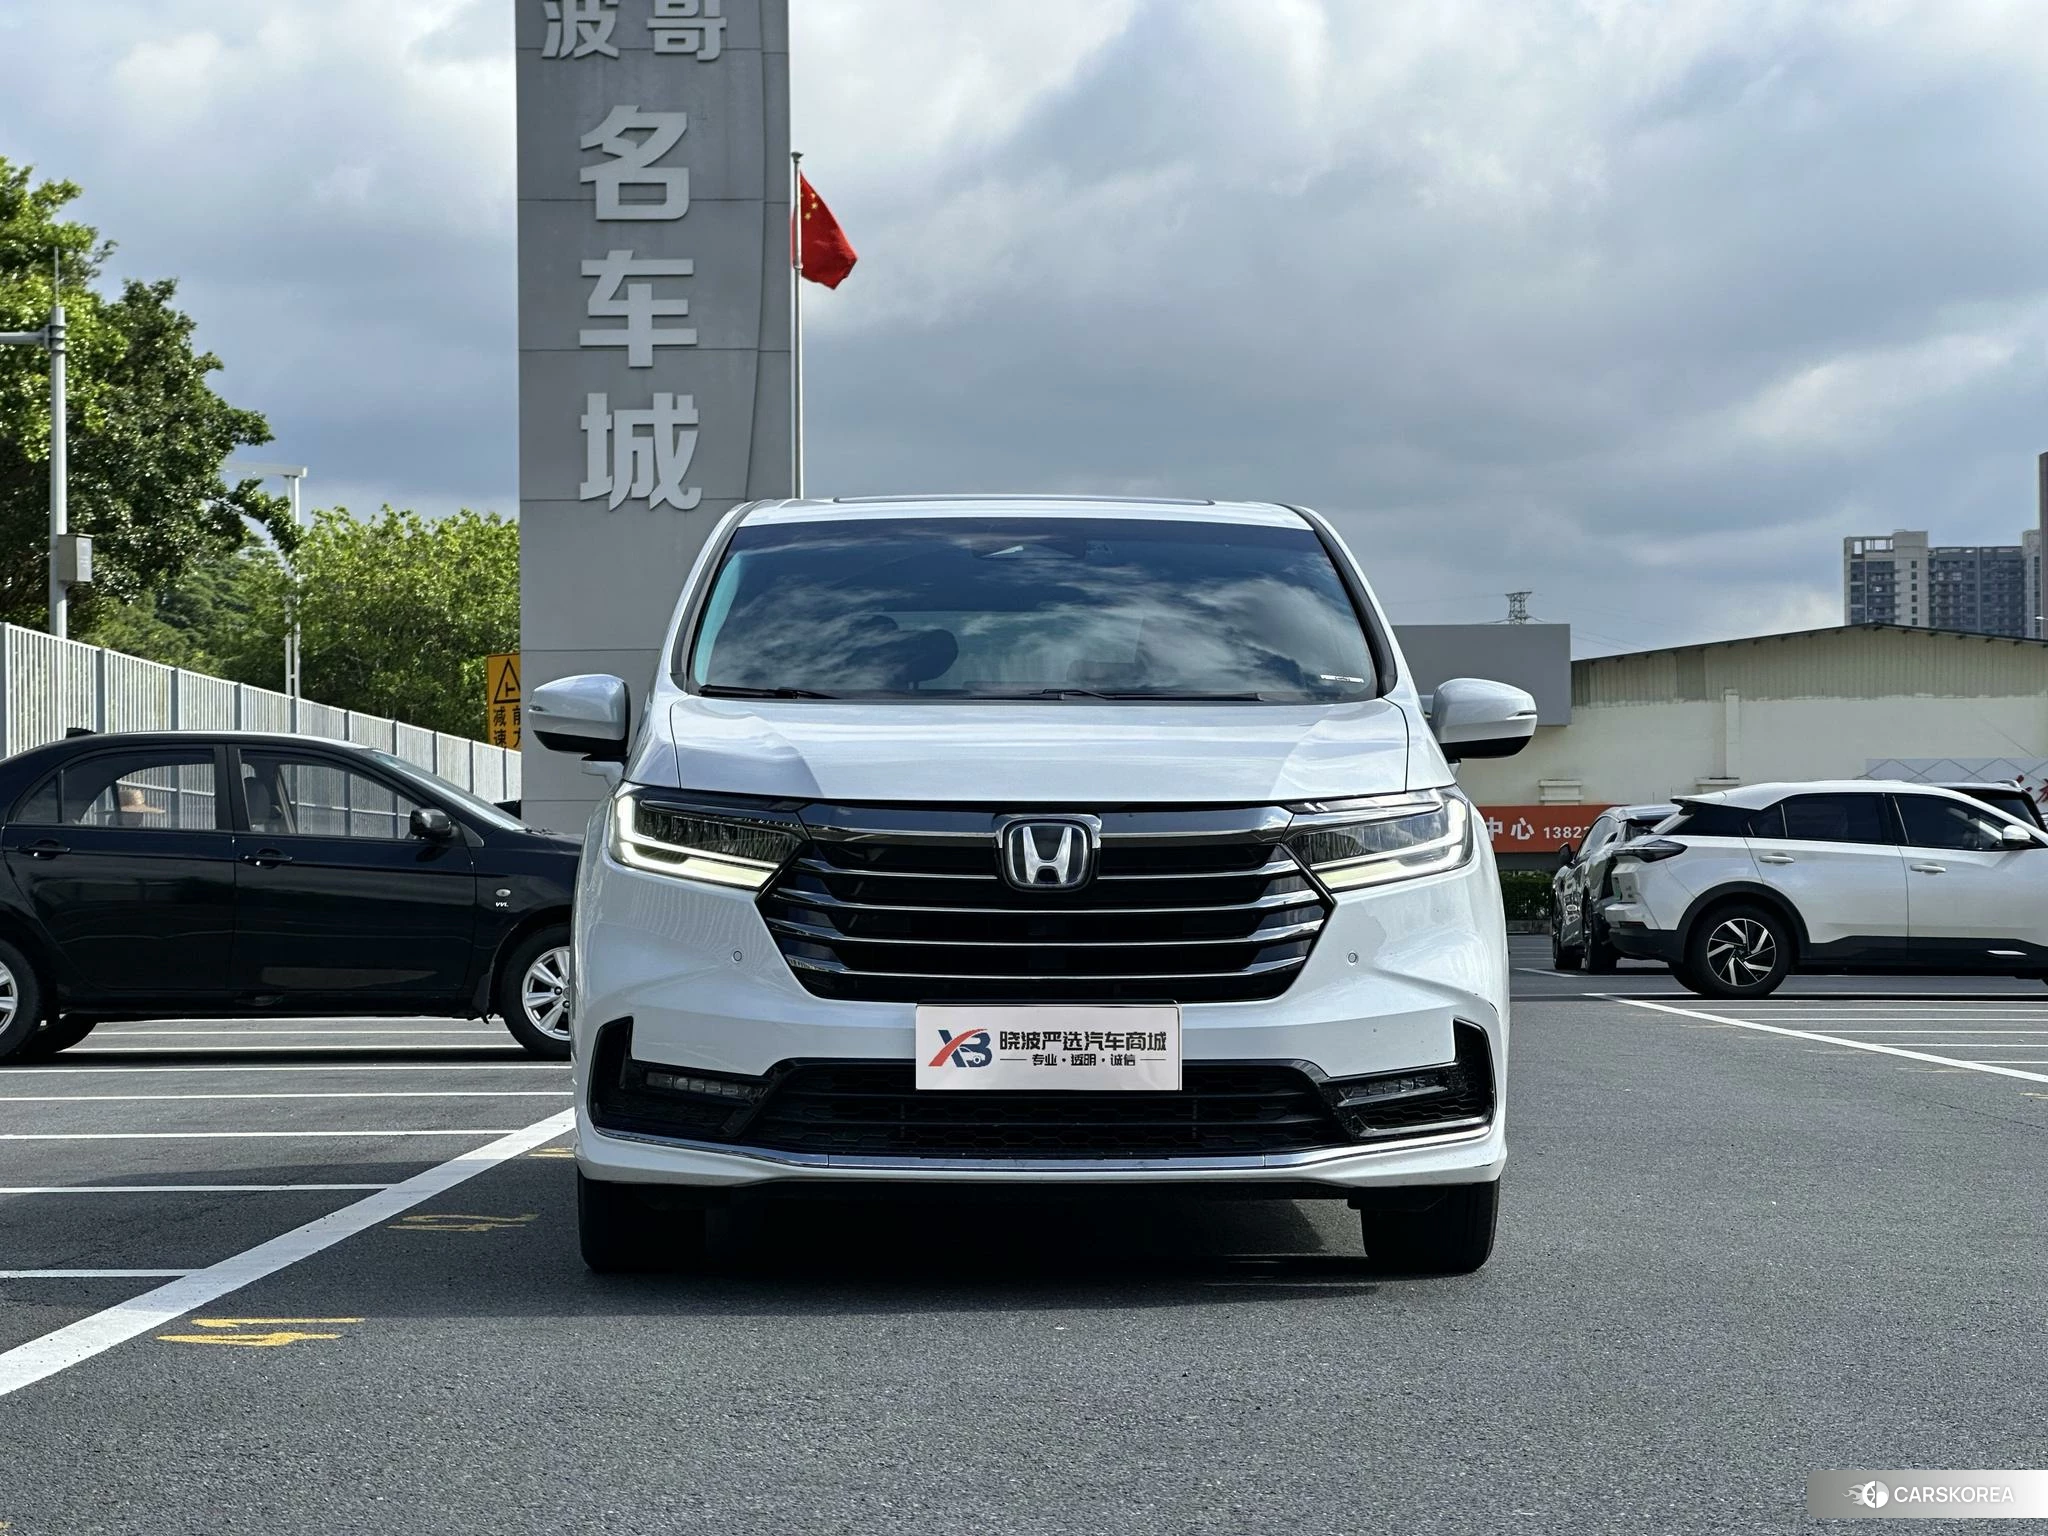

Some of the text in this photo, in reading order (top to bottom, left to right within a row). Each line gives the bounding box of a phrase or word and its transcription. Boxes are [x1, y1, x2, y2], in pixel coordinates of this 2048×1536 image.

[542, 0, 727, 61] 波哥
[580, 105, 702, 511] 名车城
[1485, 817, 1590, 841] 中心 1382
[1000, 1031, 1167, 1051] 晓波严选汽车商城
